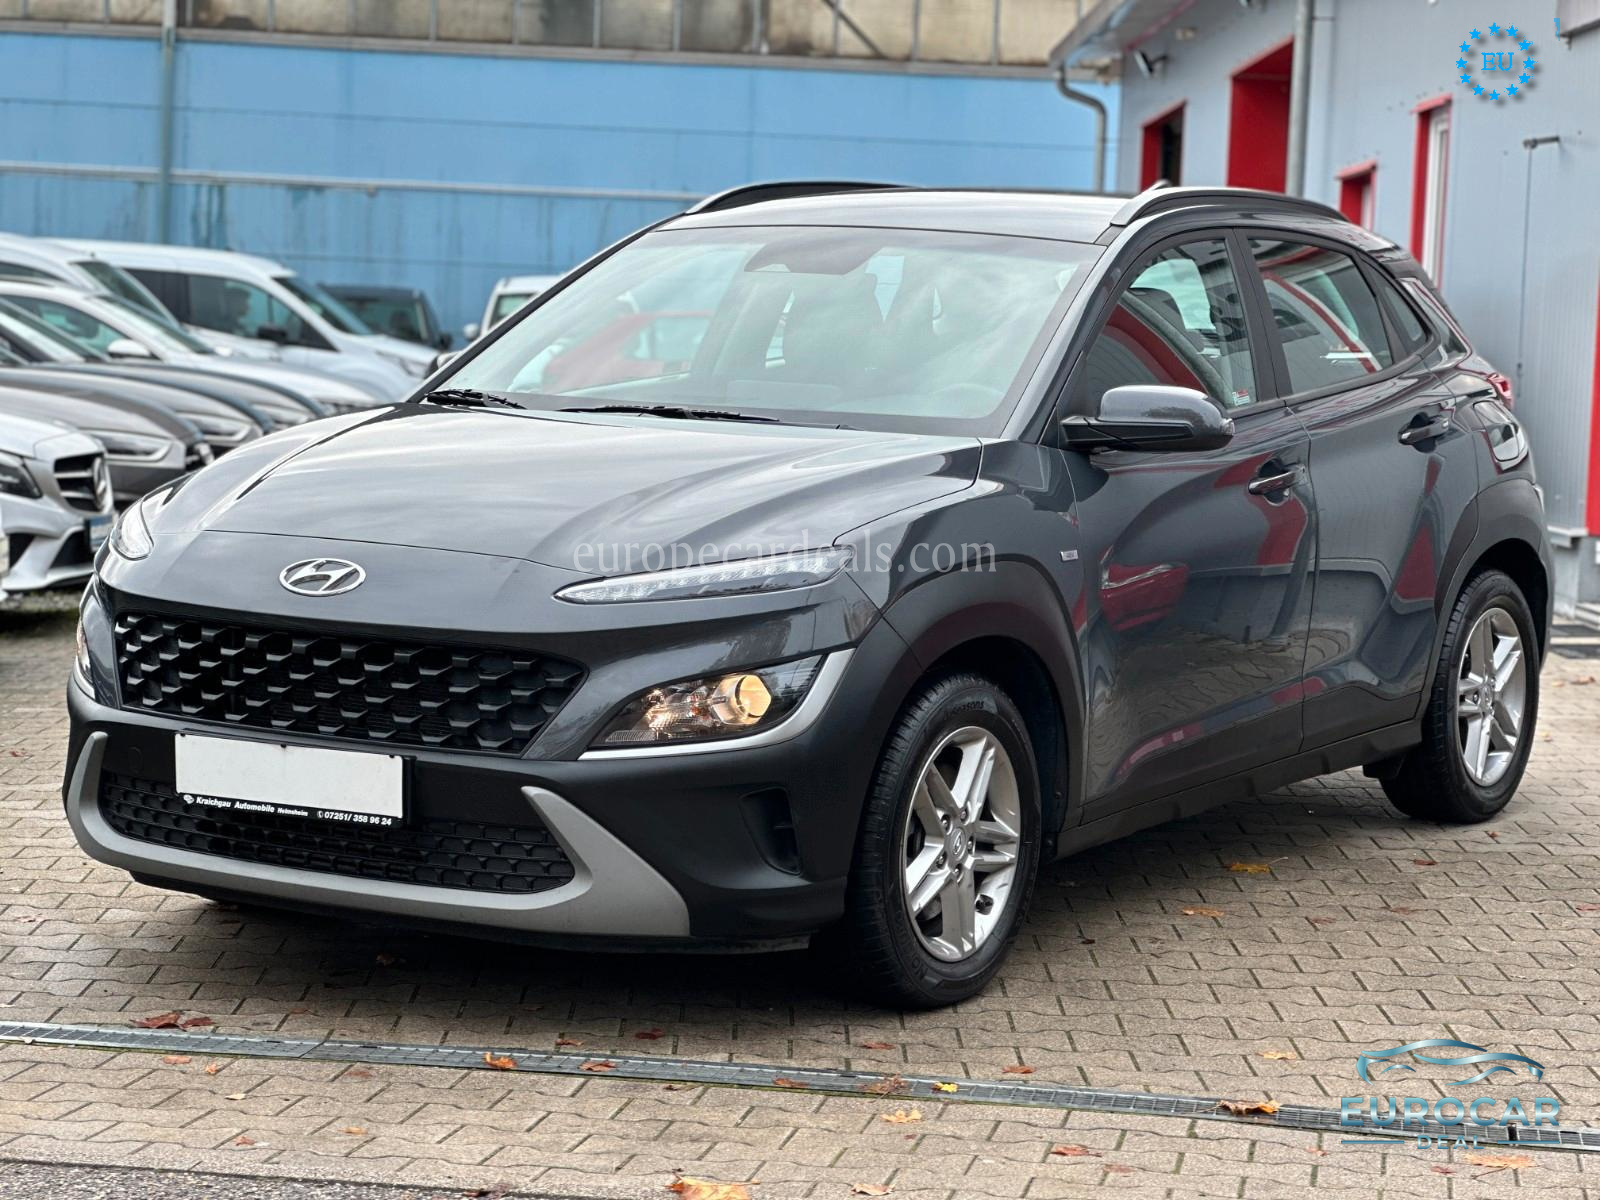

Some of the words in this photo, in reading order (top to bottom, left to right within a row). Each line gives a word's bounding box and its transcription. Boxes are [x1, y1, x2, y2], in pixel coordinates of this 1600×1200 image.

[196, 796, 231, 808] Kraichgau
[234, 801, 275, 813] Automobile
[353, 814, 368, 822] 358
[369, 816, 380, 824] 96
[381, 818, 392, 826] 24
